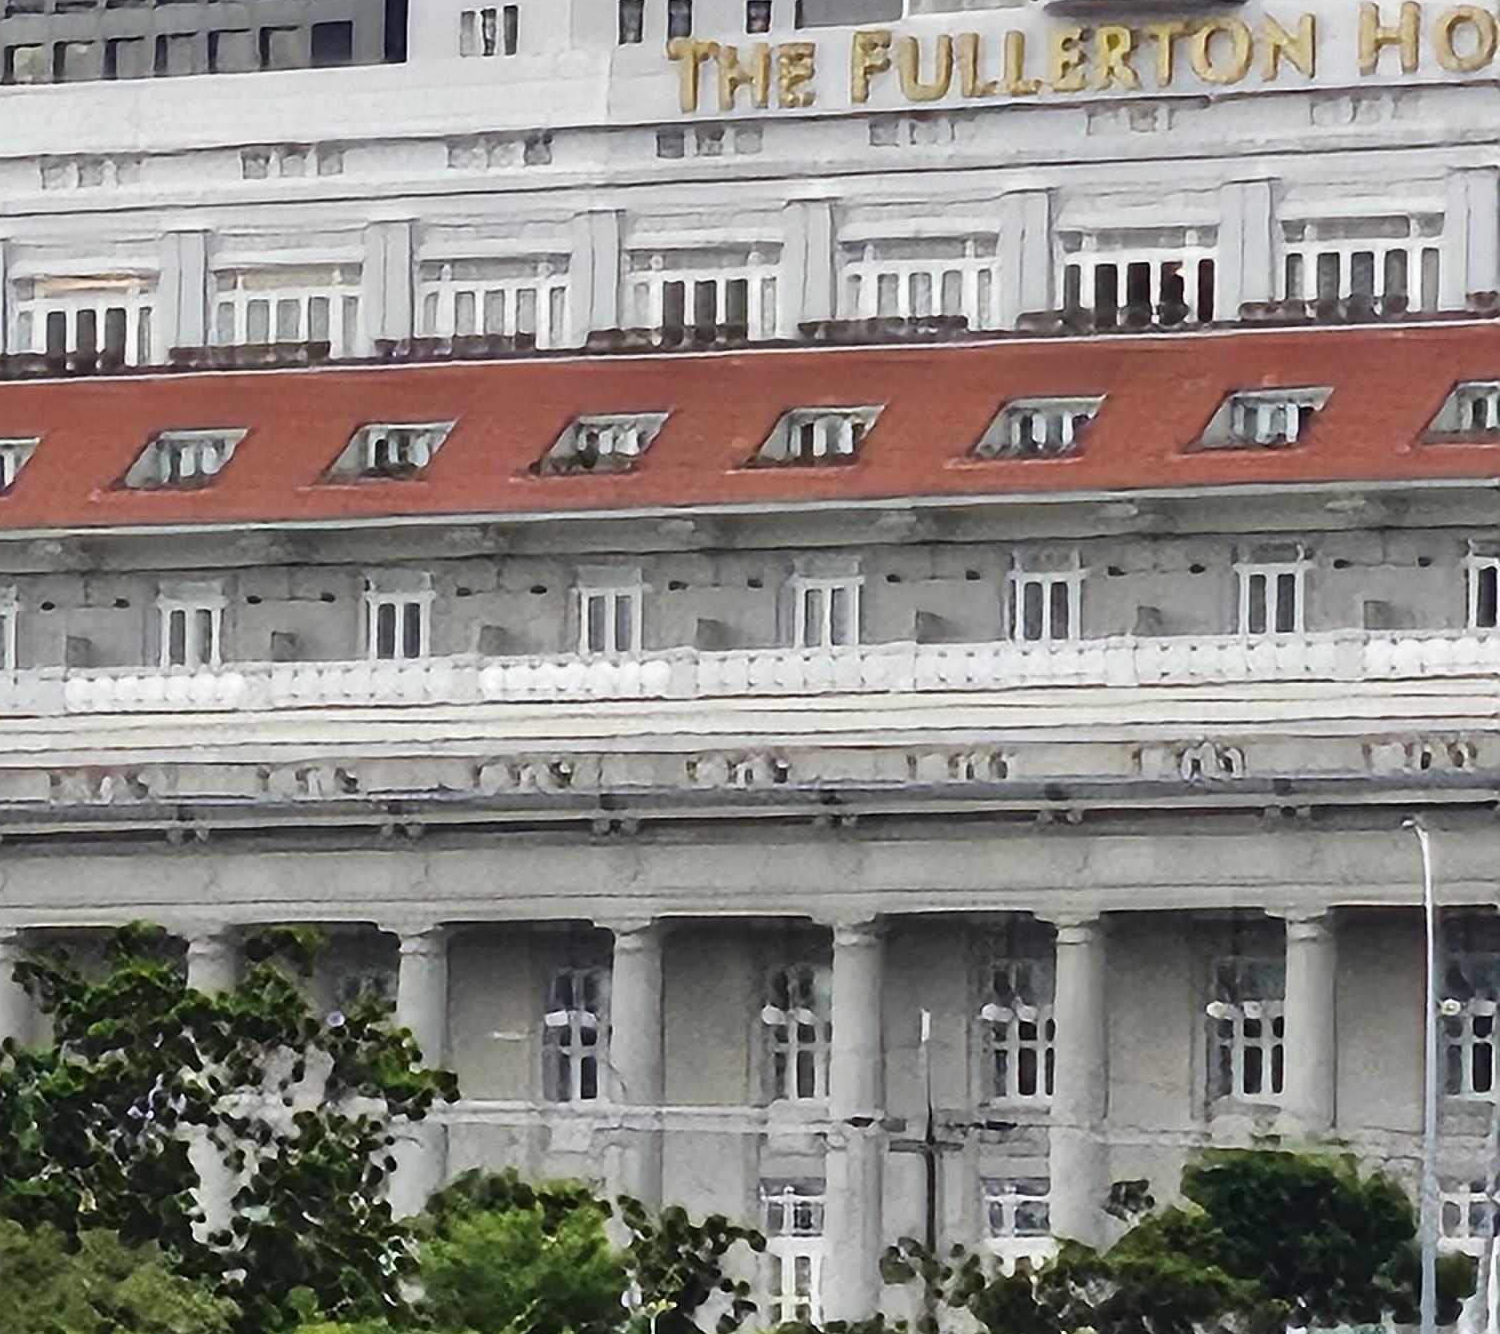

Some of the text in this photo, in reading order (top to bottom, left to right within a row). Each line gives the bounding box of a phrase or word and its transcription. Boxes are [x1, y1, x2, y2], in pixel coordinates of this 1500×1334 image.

[667, 0, 1500, 114] THE FULLERTON HO
